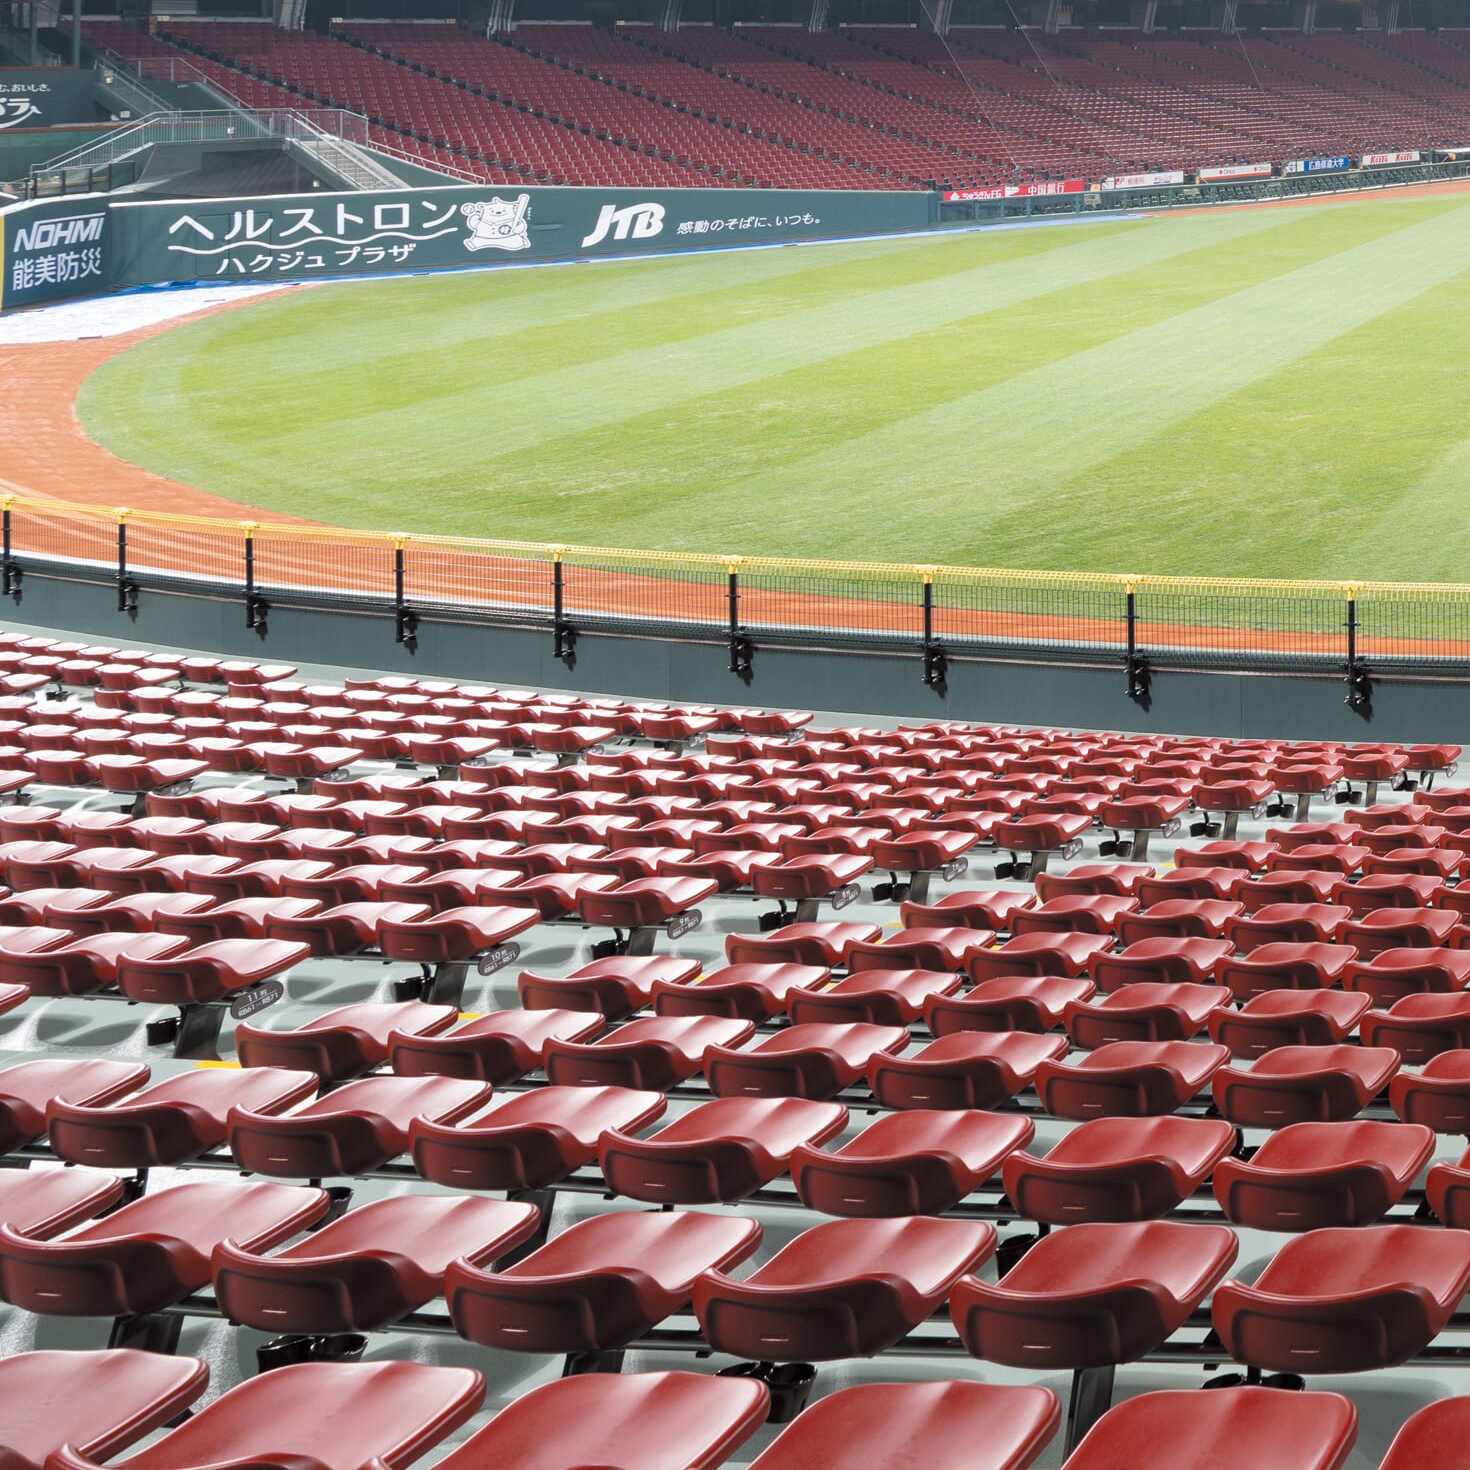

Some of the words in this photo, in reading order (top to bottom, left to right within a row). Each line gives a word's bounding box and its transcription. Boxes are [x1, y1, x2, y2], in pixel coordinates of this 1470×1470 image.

[1027, 182, 1066, 196] 中国銀行
[13, 212, 106, 252] NOHMI
[169, 201, 457, 241] ヘルストロン
[581, 202, 666, 248] JTB
[676, 213, 821, 236] 感動のそばに、いつも。
[12, 248, 102, 291] 能美防災
